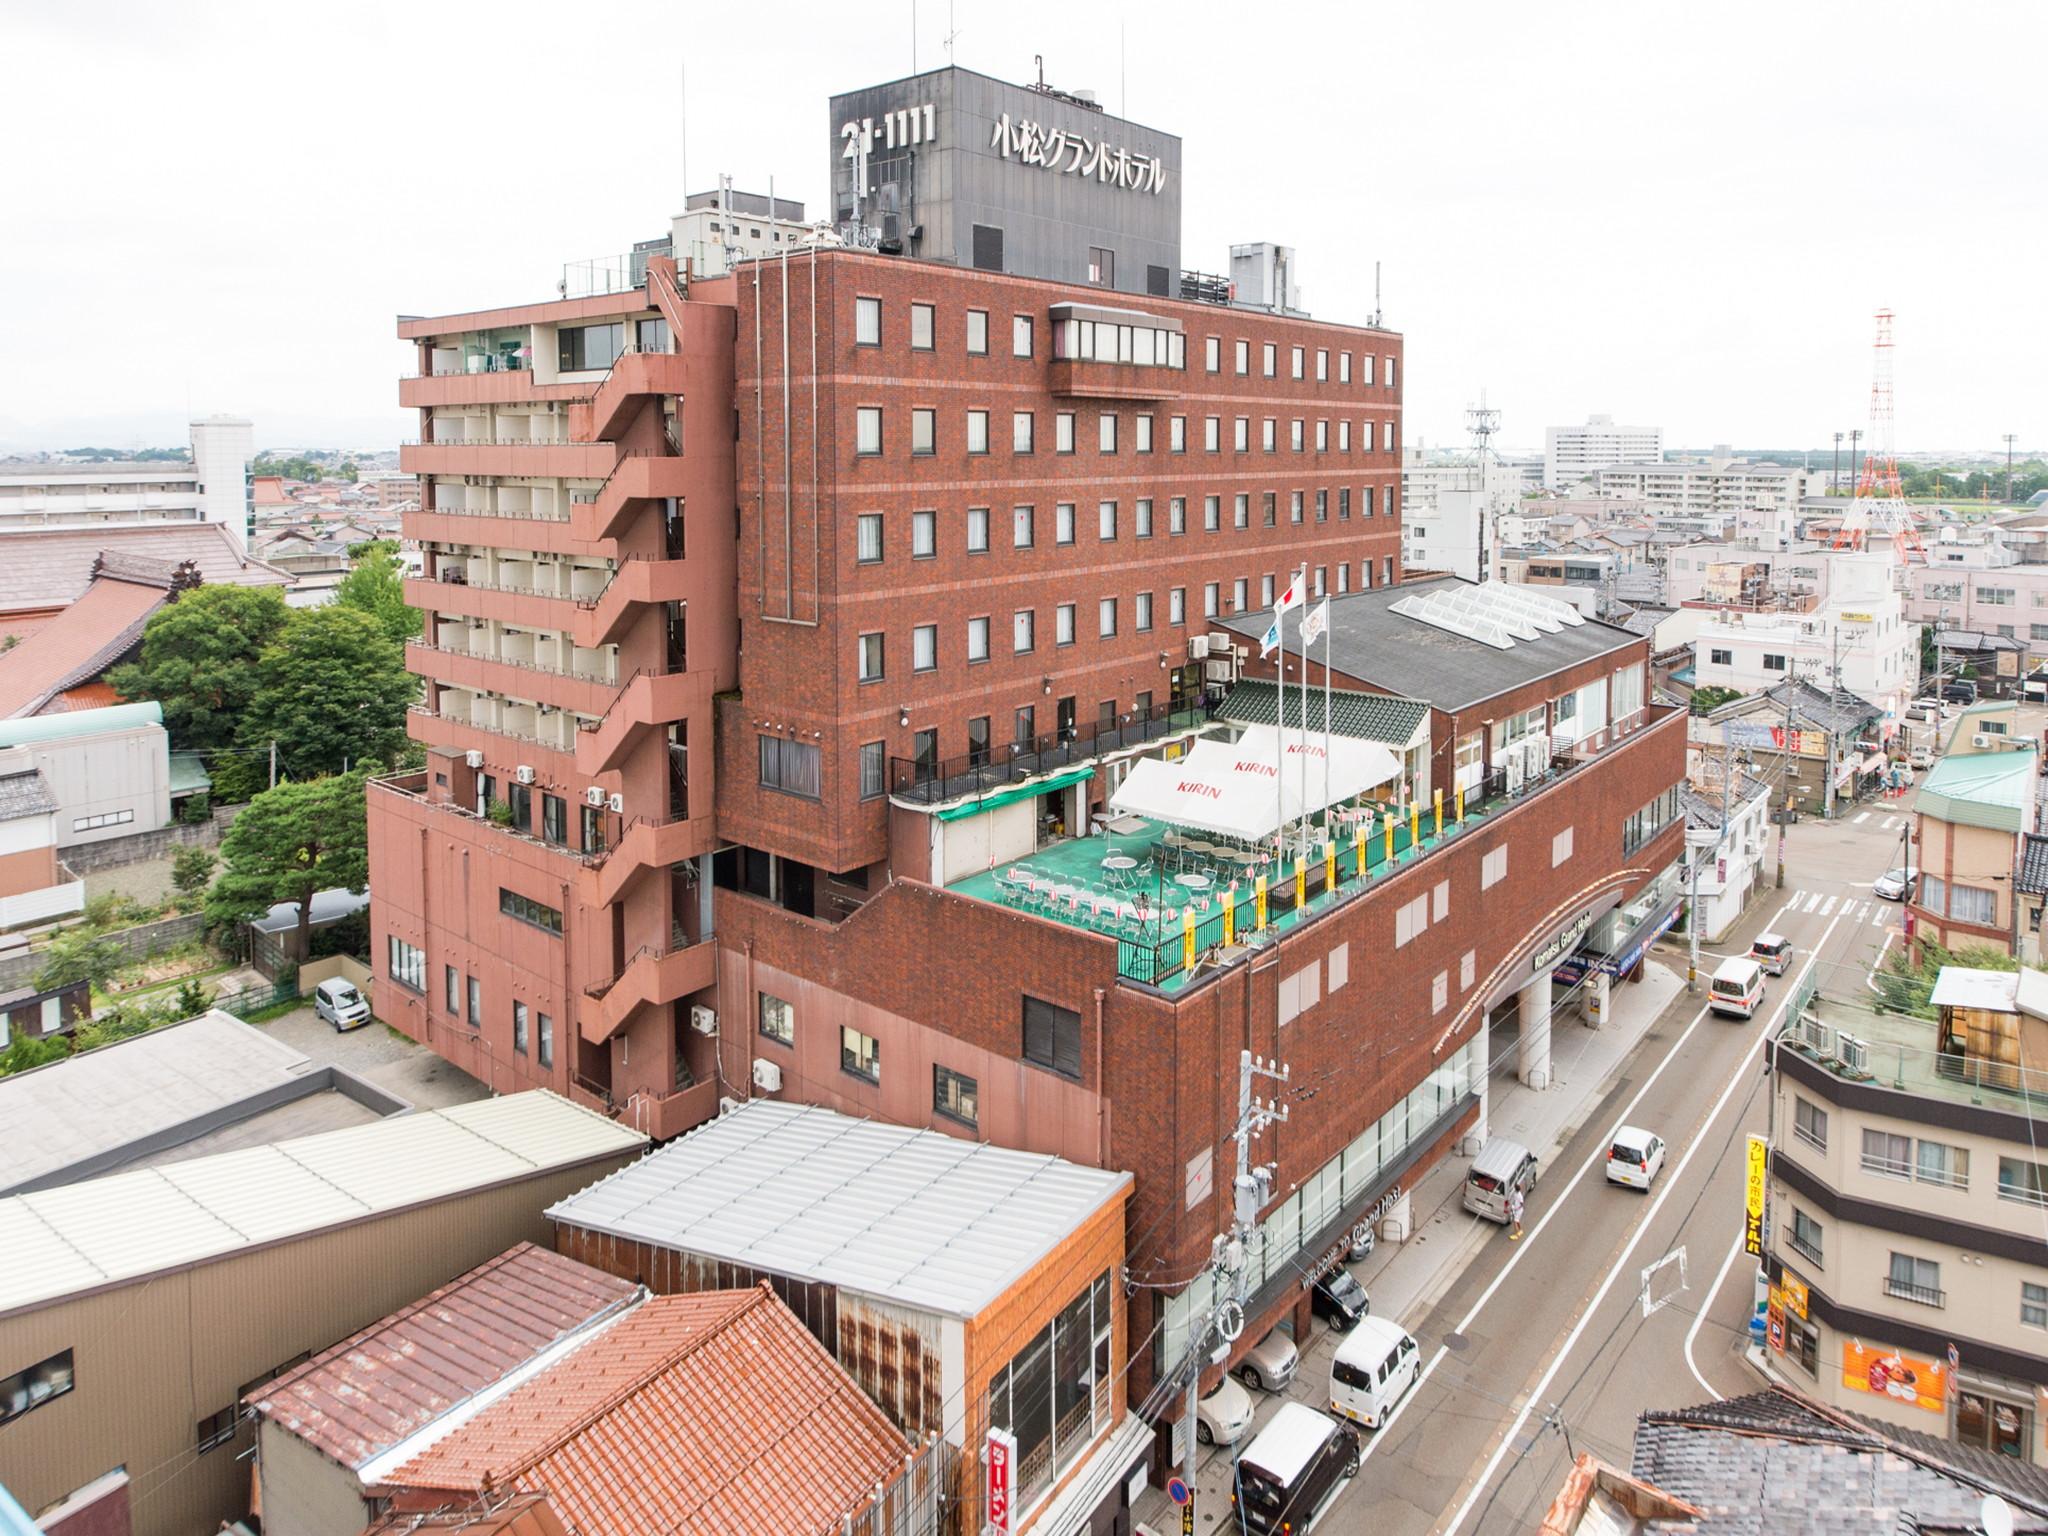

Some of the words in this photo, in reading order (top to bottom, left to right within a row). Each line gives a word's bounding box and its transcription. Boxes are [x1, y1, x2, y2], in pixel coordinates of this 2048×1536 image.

[990, 112, 1166, 194] 小松グランドホテル
[1287, 743, 1327, 758] KIRIN
[1234, 761, 1278, 777] KIRIN
[1176, 781, 1222, 799] KIRIN
[1560, 921, 1578, 948] Grand
[1352, 1204, 1380, 1241] Grand
[992, 1445, 1005, 1524] ラーメン
